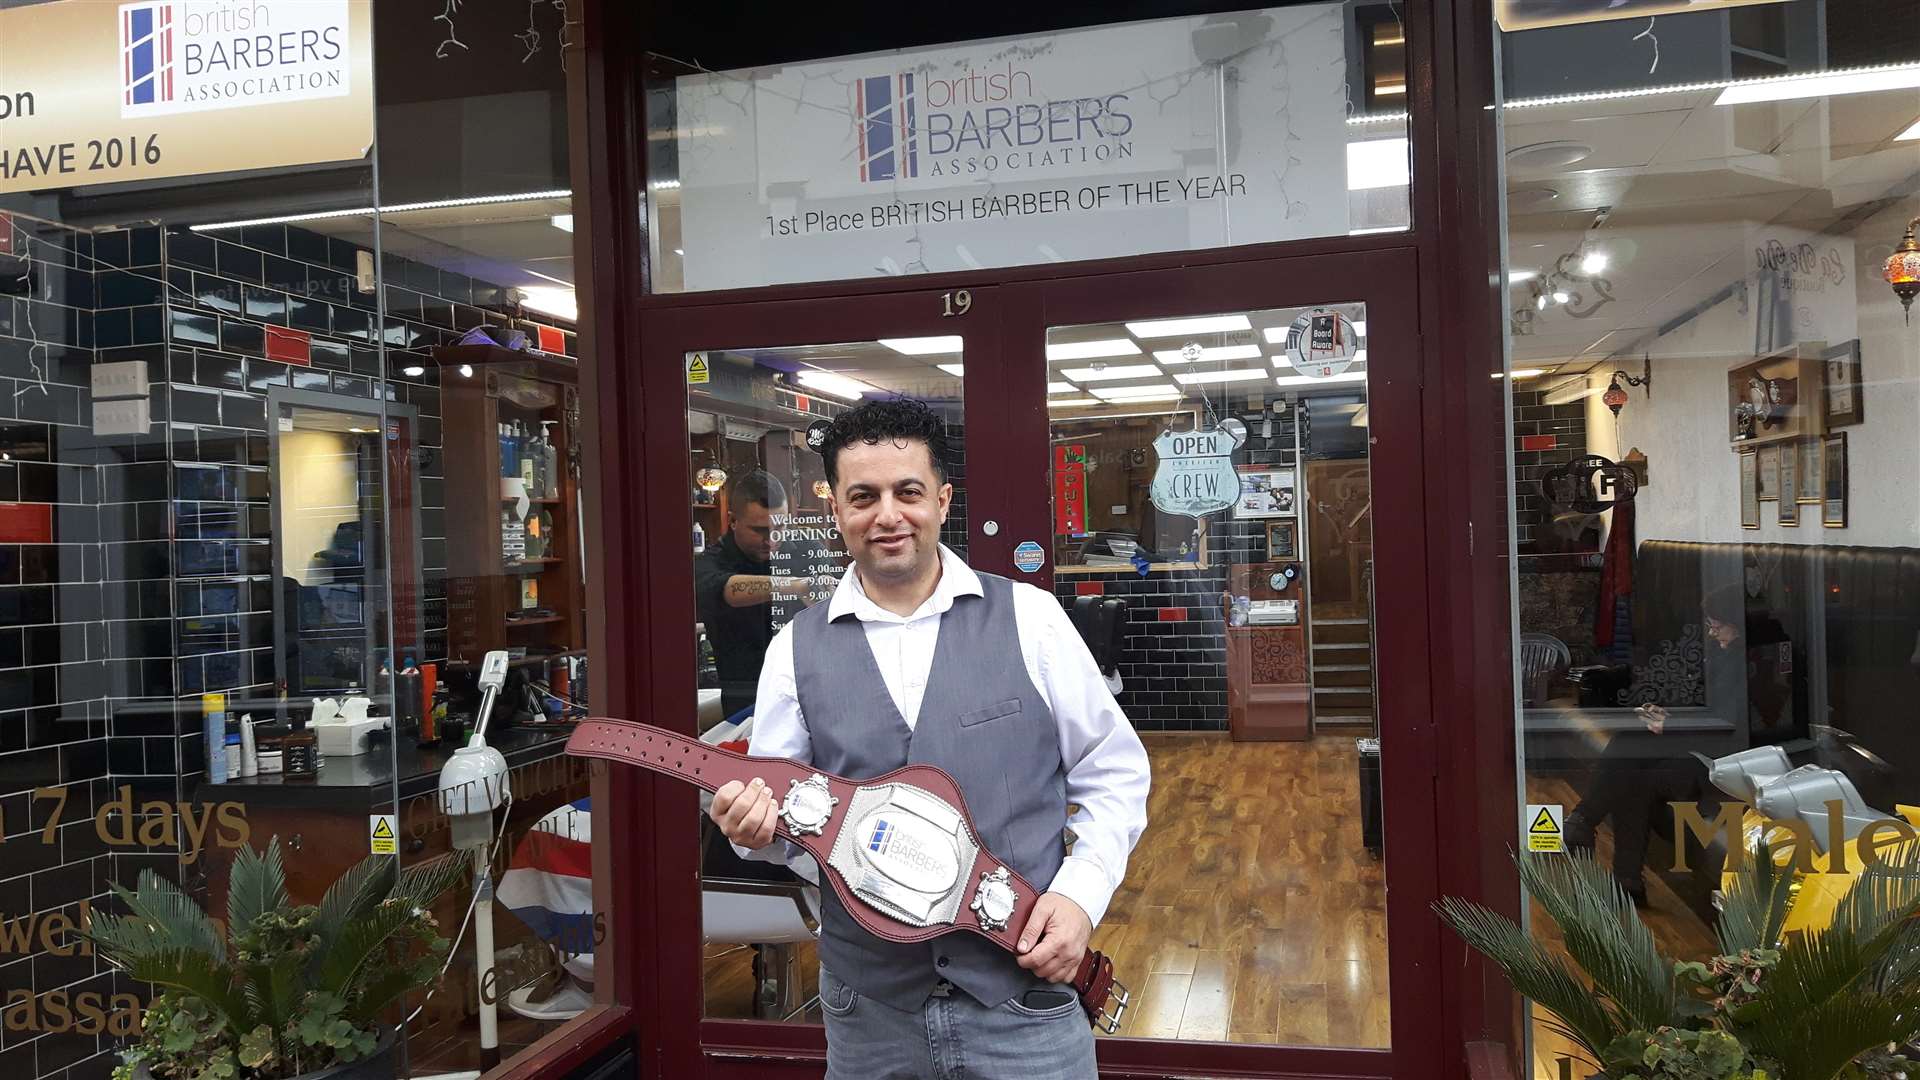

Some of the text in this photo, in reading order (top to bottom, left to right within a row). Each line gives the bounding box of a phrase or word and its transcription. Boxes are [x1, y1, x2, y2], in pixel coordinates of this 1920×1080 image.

[183, 0, 270, 36] british
[185, 26, 342, 75] BARBERS
[183, 69, 342, 103] ASSOCIATION
[925, 62, 1032, 107] british
[928, 94, 1133, 154] BARBERS
[88, 134, 161, 170] 2016
[930, 142, 1133, 176] ASSOCIATION
[766, 174, 1247, 236] 1st Place BRITISH BARBER OF THE YEAR
[941, 290, 972, 317] 19
[1312, 340, 1332, 349] Aware
[1313, 328, 1332, 338] Board
[1173, 436, 1217, 455] OPEN
[1173, 473, 1219, 498] CREW
[770, 512, 824, 525] Welcome
[769, 528, 838, 542] OPENING
[770, 551, 792, 560] Mon
[770, 566, 791, 575] Tues
[771, 577, 791, 586] Wed
[771, 591, 798, 600] Thurs
[771, 606, 785, 616] Fri
[408, 780, 476, 838] GIFT
[32, 786, 67, 845] 7
[95, 785, 250, 864] days
[1667, 799, 1918, 875] Male
